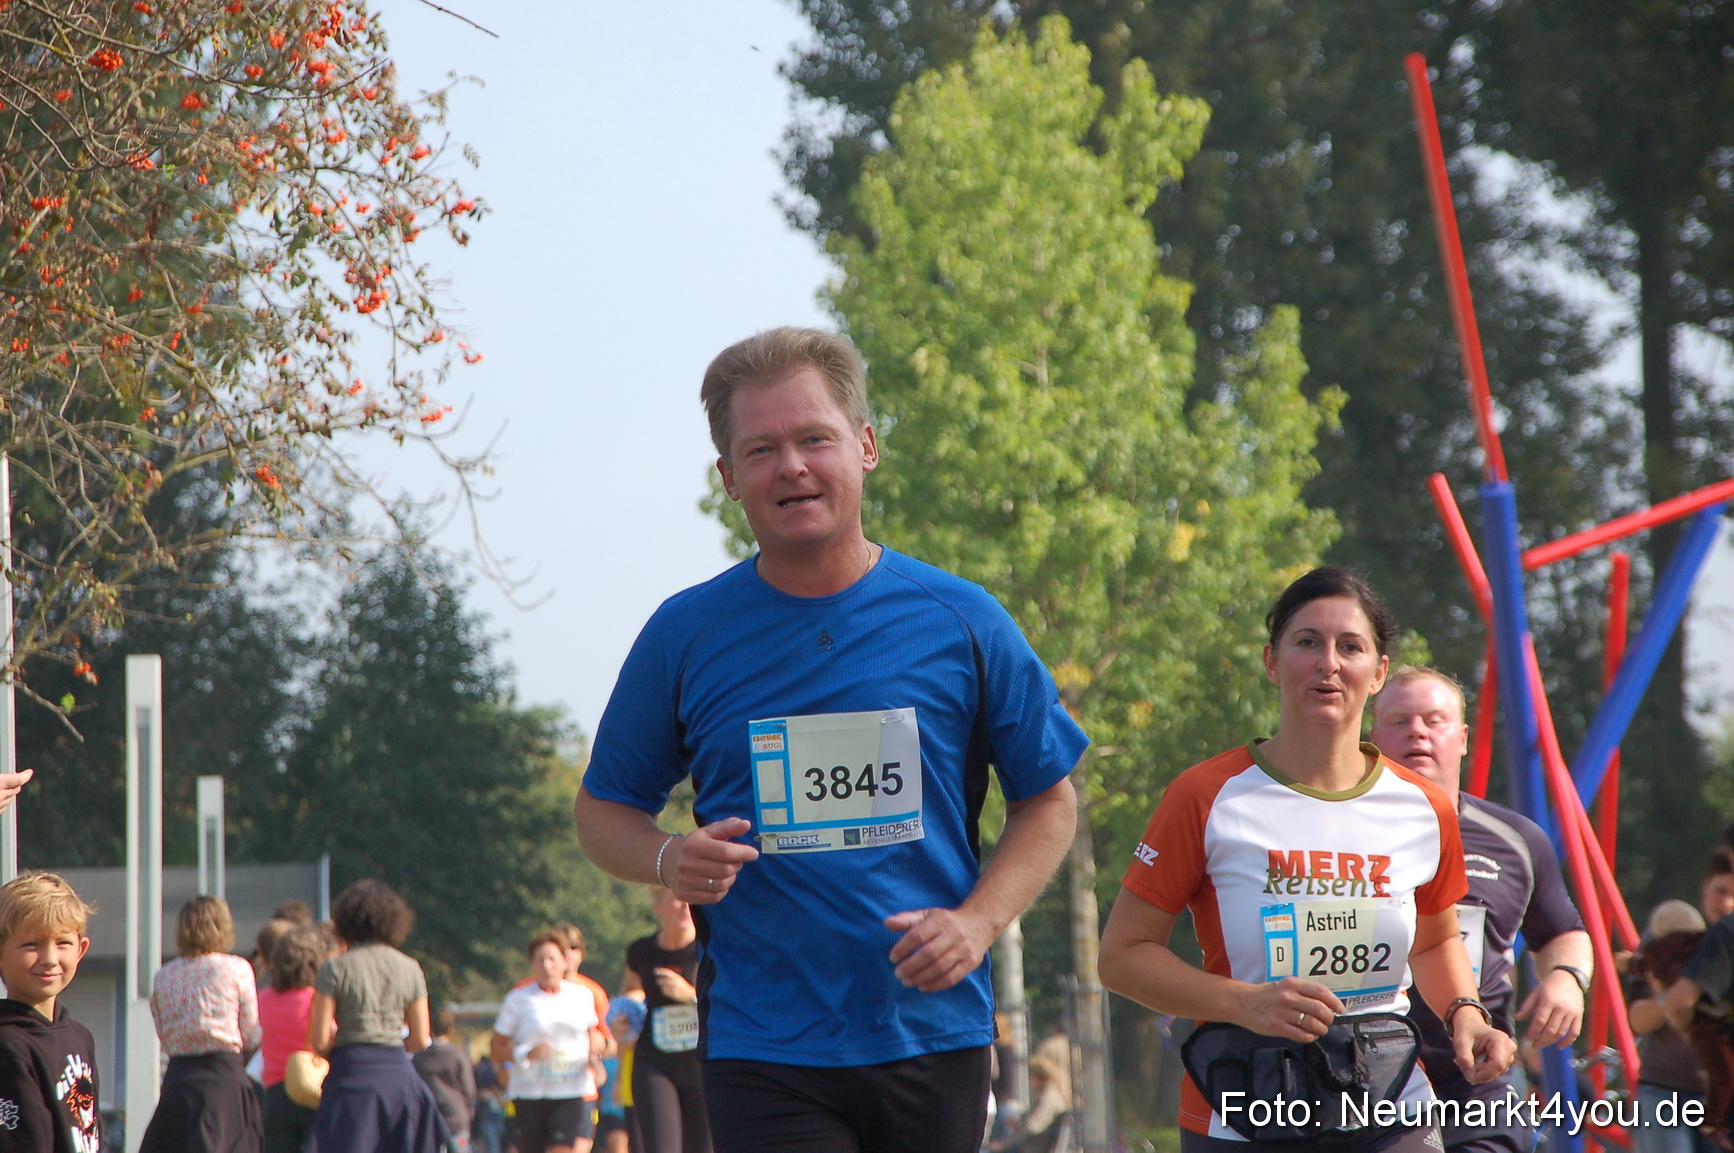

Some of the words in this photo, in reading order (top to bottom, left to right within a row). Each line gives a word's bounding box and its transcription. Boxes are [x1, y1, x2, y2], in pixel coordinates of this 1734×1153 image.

[805, 762, 904, 801] 3845
[777, 834, 819, 847] BOCK
[862, 819, 920, 838] PFLEIDERER
[1133, 841, 1160, 867] ERZ
[1268, 849, 1392, 886] MERZ
[1263, 867, 1368, 897] Reisen
[1306, 908, 1357, 932] Astrid
[1276, 946, 1285, 963] D
[1308, 942, 1392, 977] 2882
[1348, 990, 1397, 1006] PFLEIDERER
